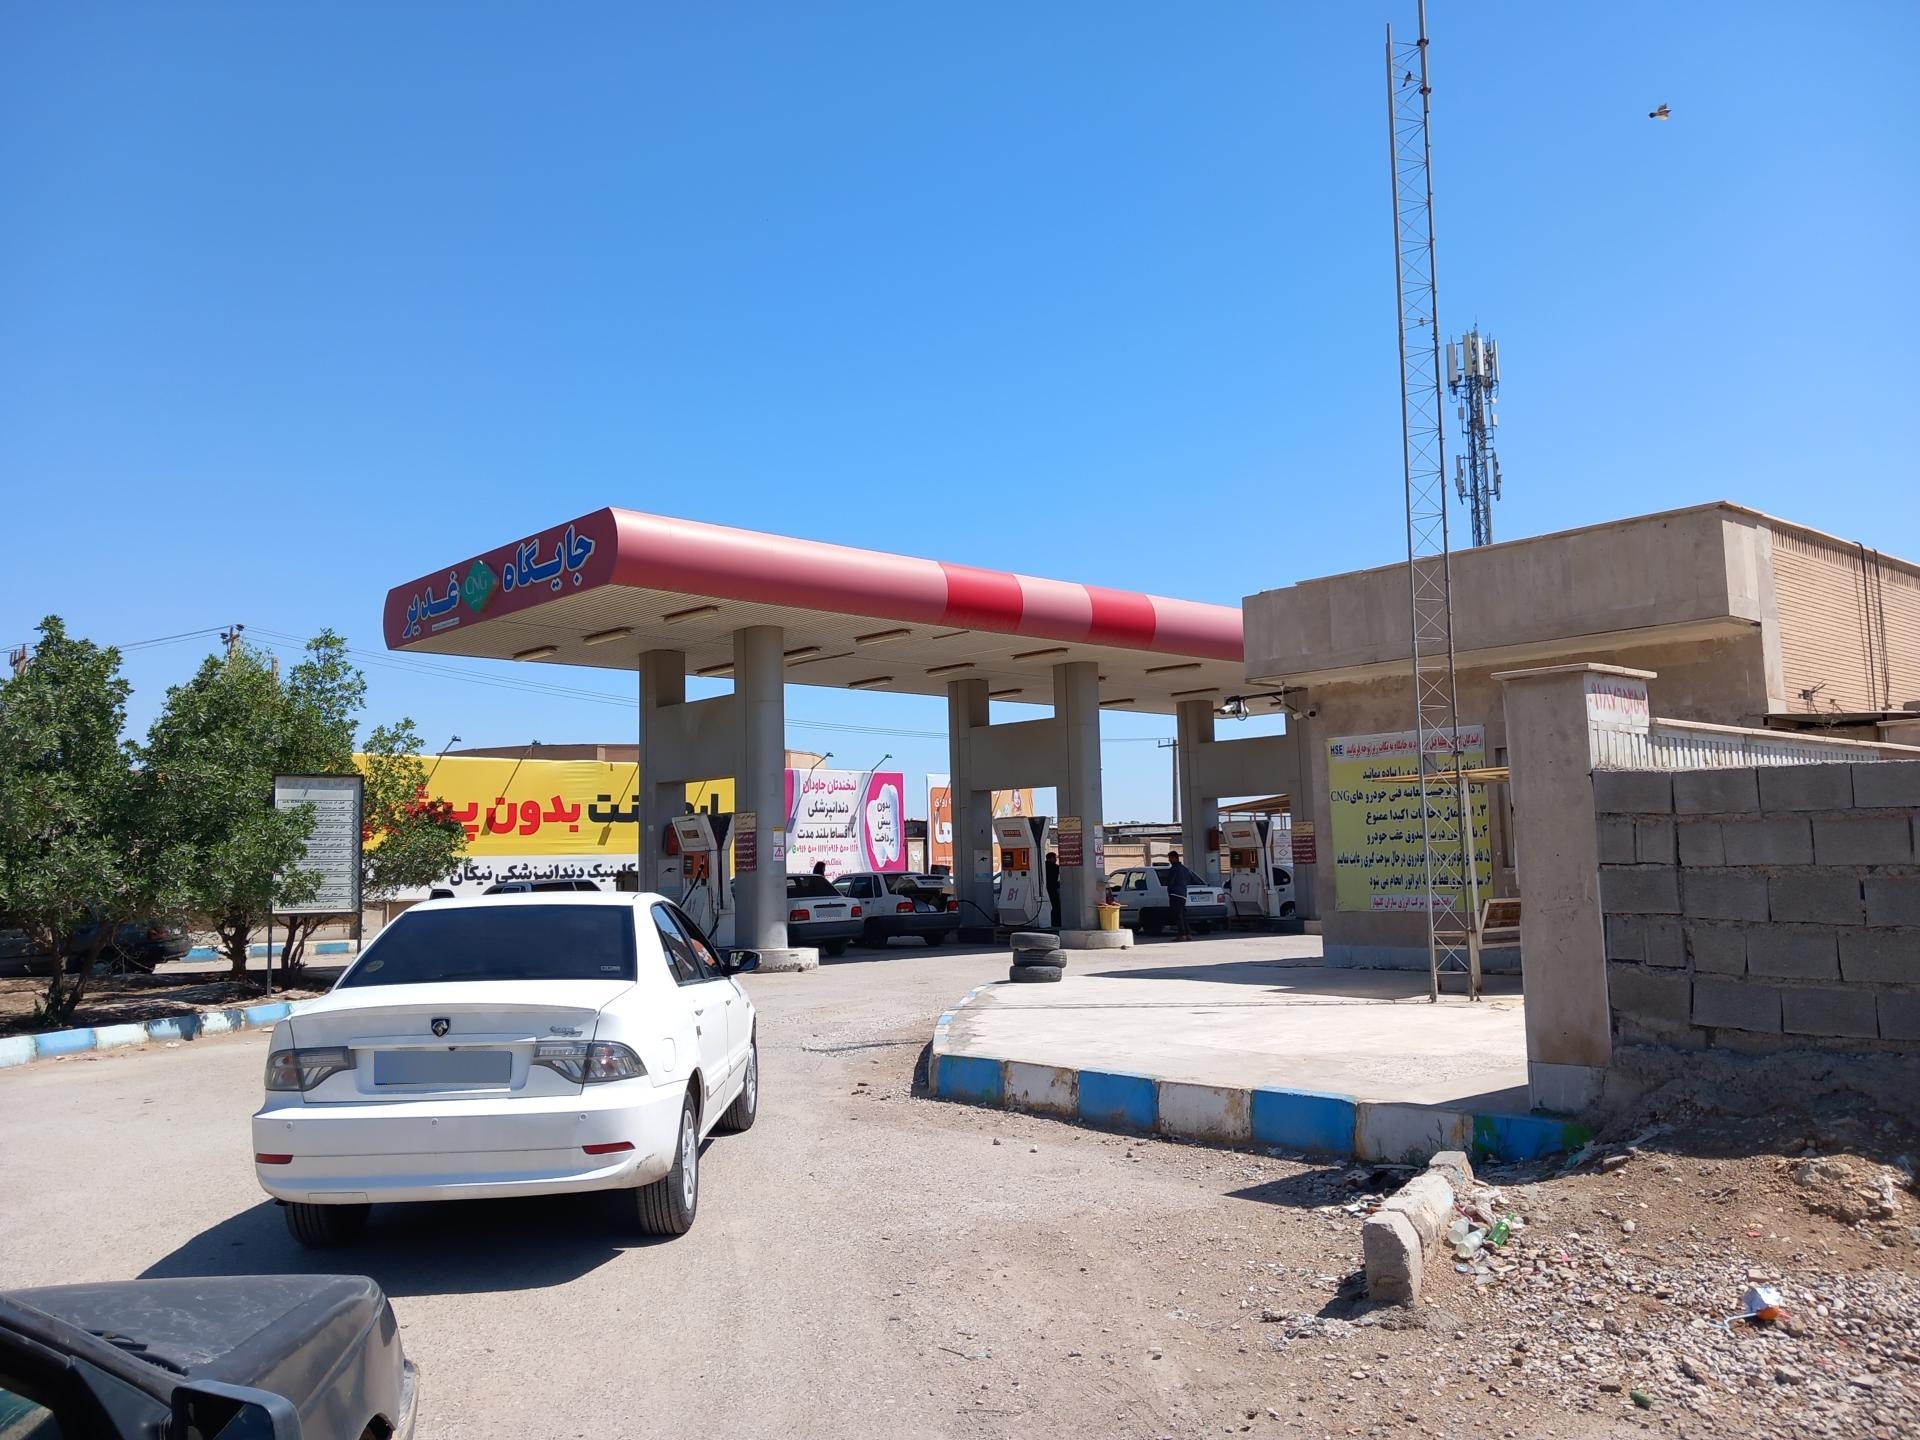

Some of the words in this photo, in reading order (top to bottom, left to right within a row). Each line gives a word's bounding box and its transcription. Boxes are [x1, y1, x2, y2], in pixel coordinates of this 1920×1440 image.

[503, 524, 596, 592] جایگاه
[465, 571, 488, 595] CNG
[402, 570, 461, 639] غدیر
[1330, 745, 1343, 755] HSE
[828, 778, 857, 795] لبخندتان
[1389, 786, 1402, 802] فنی
[1366, 788, 1387, 804] خودرو
[486, 793, 580, 834] بدون
[808, 799, 849, 821] دندانپزشکی
[877, 801, 891, 813] بدون
[1476, 804, 1487, 817] ۳.
[878, 814, 892, 832] پیش
[1366, 811, 1388, 825] ممنوع
[1390, 808, 1409, 823] اکیدا
[797, 829, 815, 840] مدت
[816, 827, 829, 843] بلند
[1366, 832, 1388, 845] خودرو
[1479, 824, 1488, 838] ۴.
[874, 832, 895, 848] پرداخت
[450, 862, 493, 887] نیکان
[1240, 882, 1250, 894] C1
